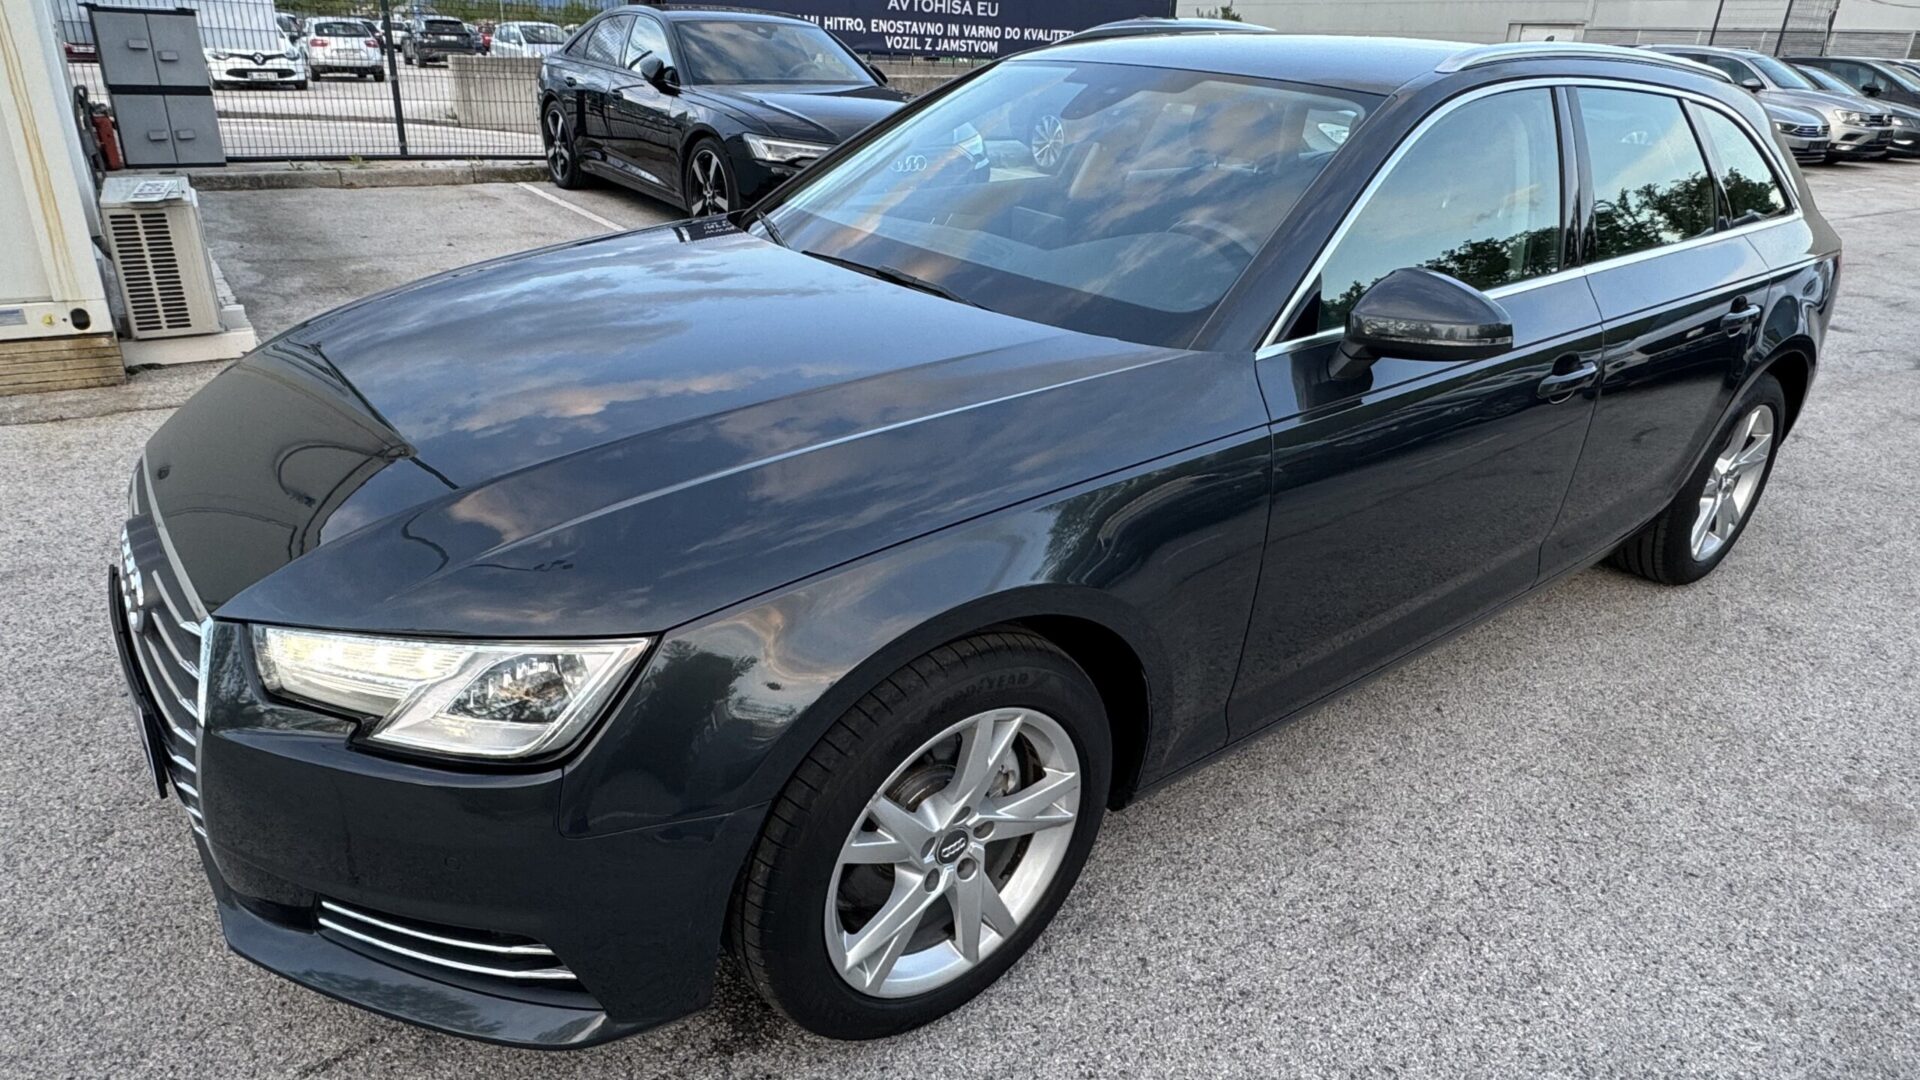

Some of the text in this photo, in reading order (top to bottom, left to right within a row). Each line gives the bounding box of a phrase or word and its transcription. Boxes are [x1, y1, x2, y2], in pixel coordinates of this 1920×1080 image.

[977, 1, 999, 17] EU
[824, 16, 866, 34] HITRO,
[871, 19, 943, 36] ENOSTAVNO
[947, 24, 959, 37] IN
[963, 25, 1001, 39] VARNO
[1005, 27, 1020, 40] DO
[885, 35, 998, 53] VOZIL Z JAMSTVOM
